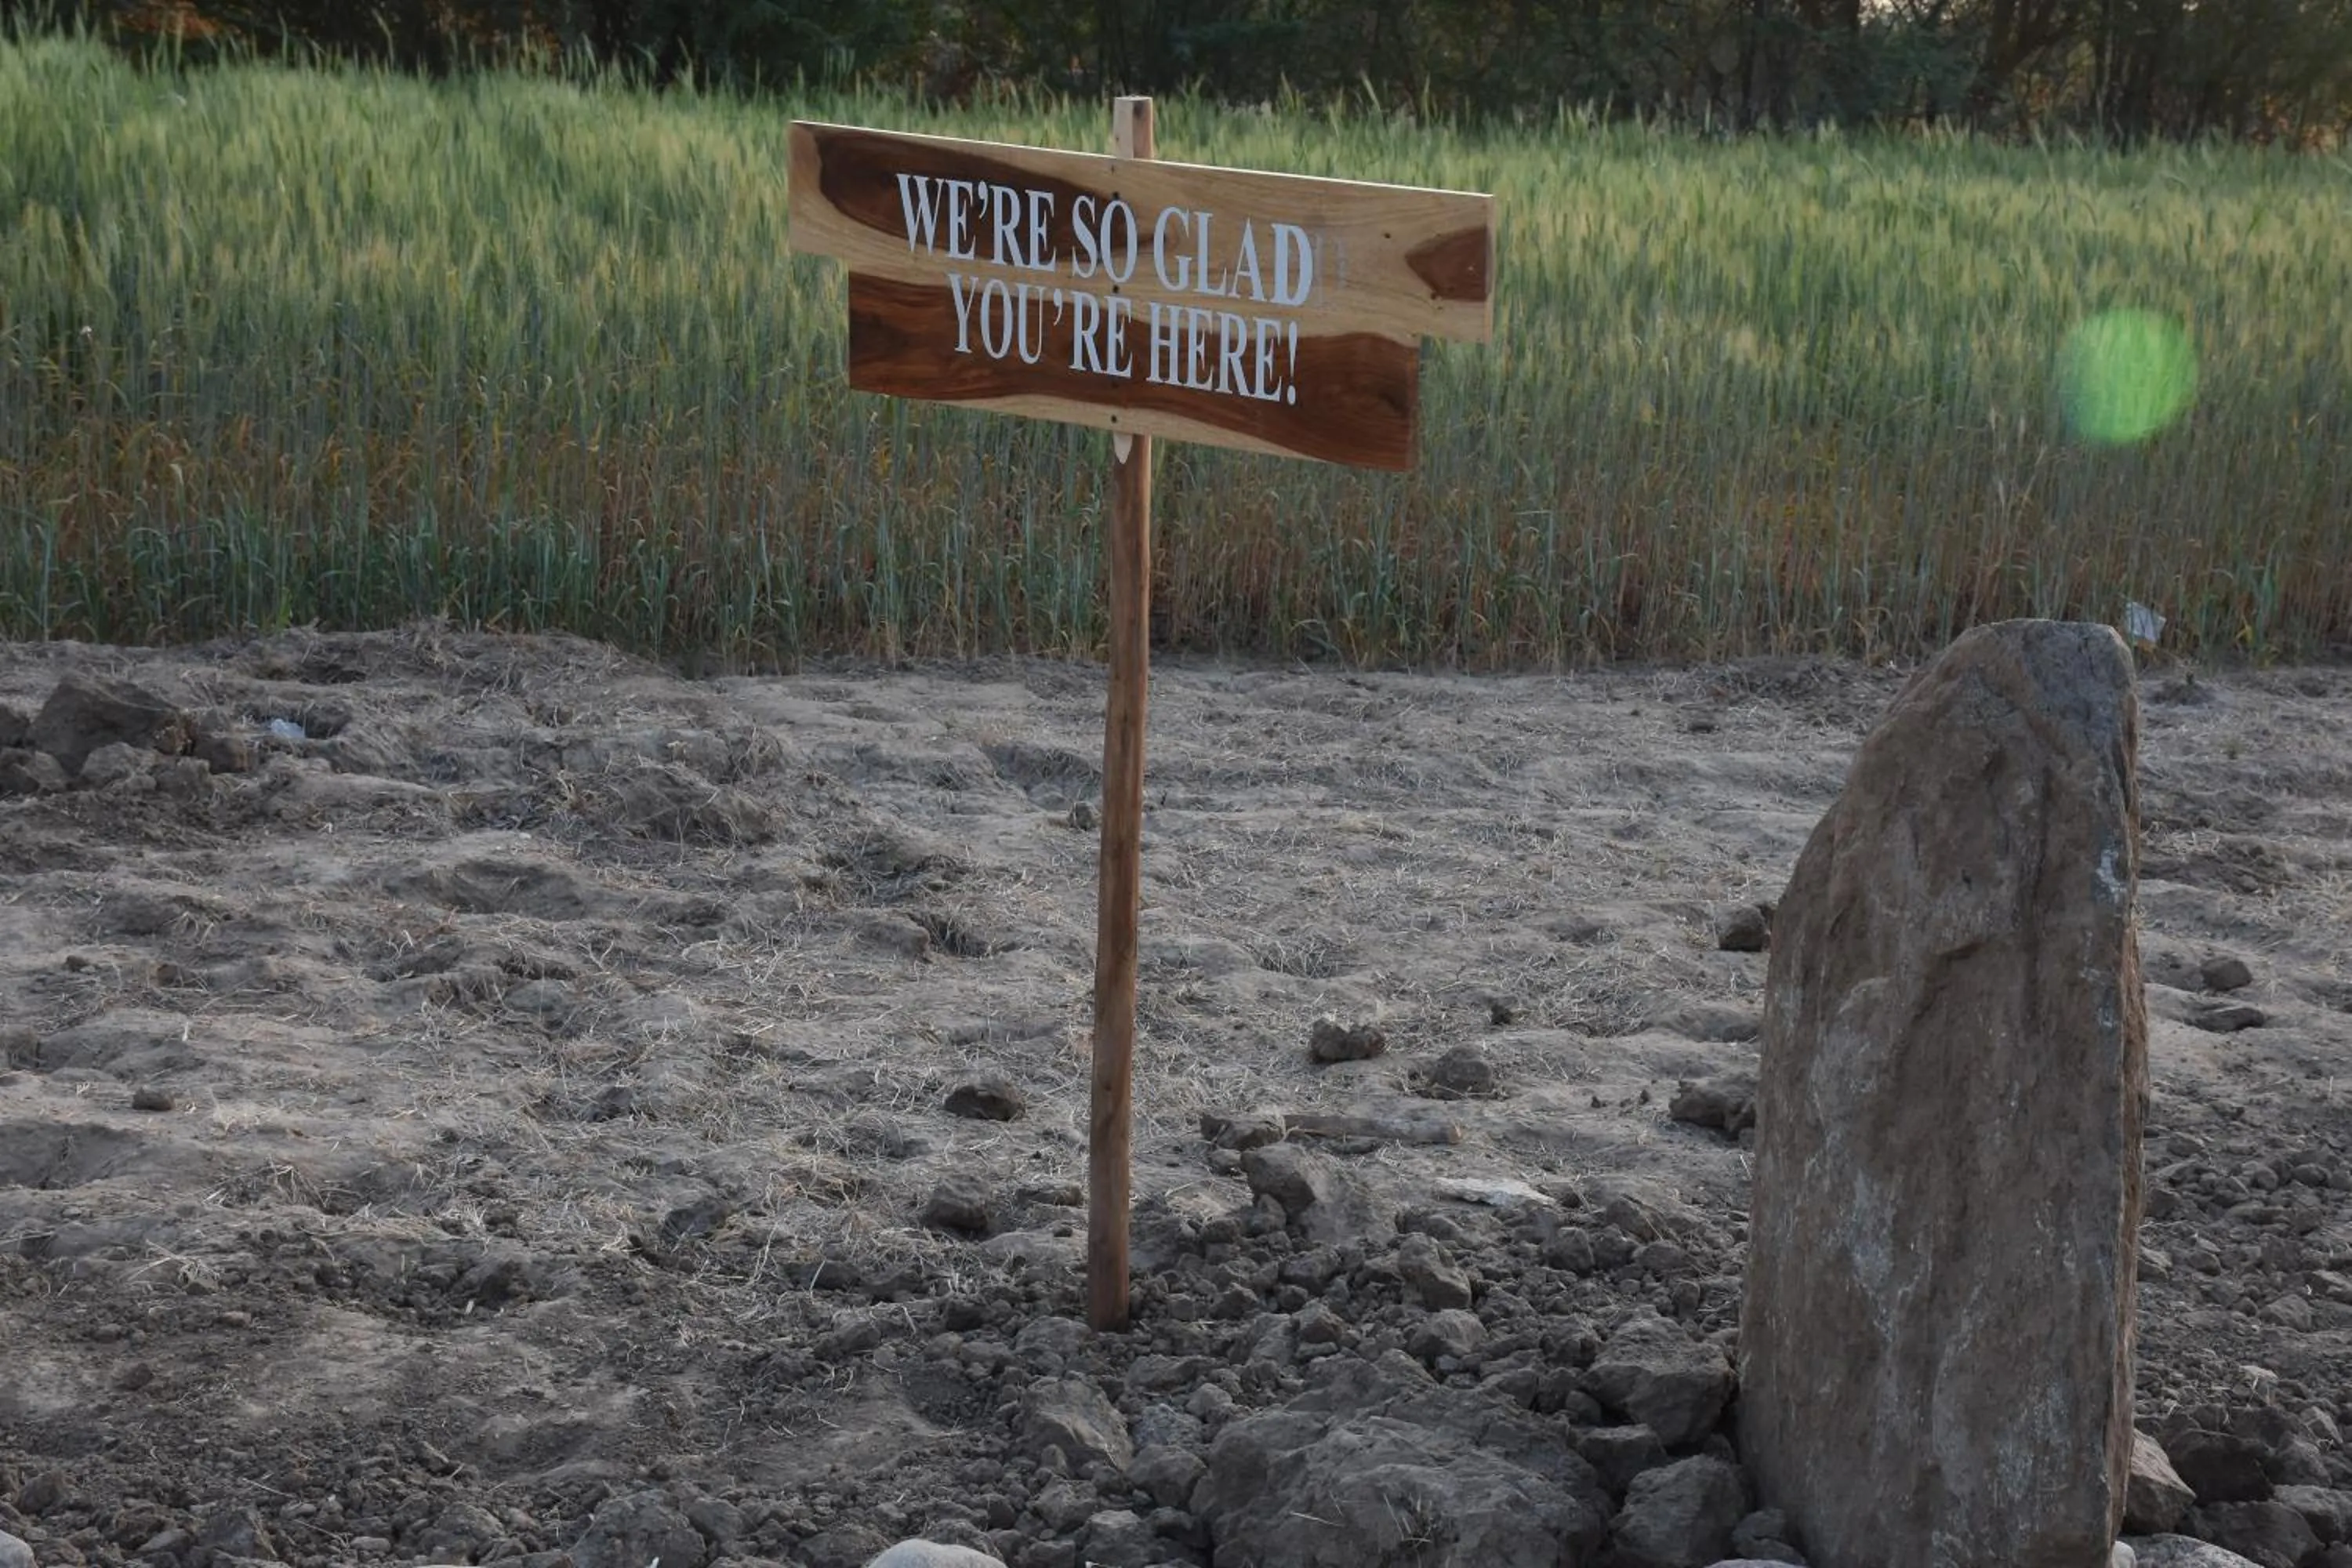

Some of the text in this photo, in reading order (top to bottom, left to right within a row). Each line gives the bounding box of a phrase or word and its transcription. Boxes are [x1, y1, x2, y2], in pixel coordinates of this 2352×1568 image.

[895, 172, 1314, 307] WE'RE SO GLAD
[948, 273, 1298, 405] YOU'RE HERE!
